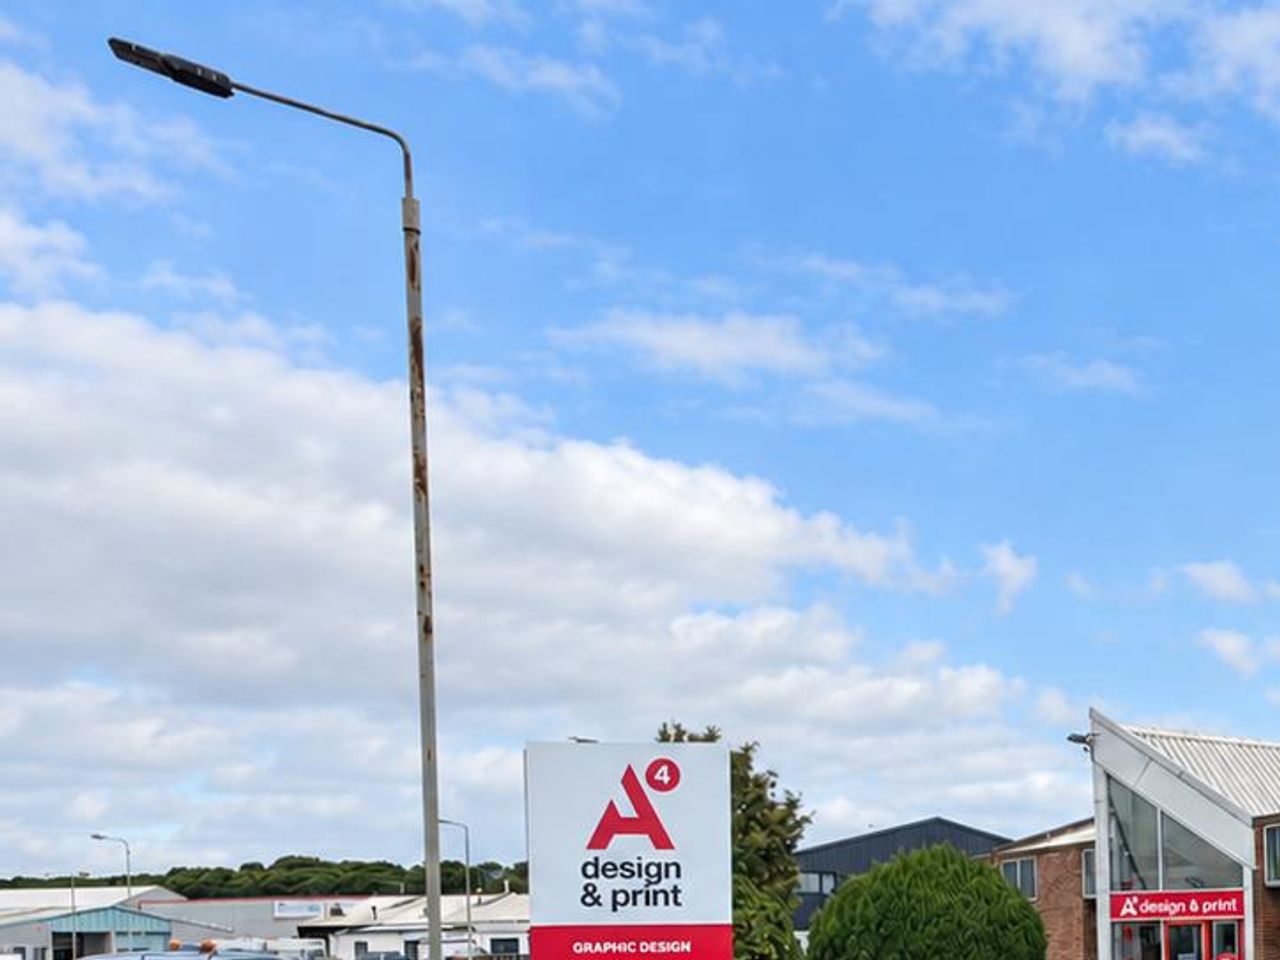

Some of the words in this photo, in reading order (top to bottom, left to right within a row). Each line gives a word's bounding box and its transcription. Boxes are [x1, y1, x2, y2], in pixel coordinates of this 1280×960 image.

[580, 856, 682, 888] design
[580, 882, 603, 908] &
[611, 884, 682, 912] print
[1139, 899, 1186, 915] design
[1202, 898, 1237, 914] print
[572, 941, 637, 954] GRAPHIC
[639, 940, 692, 953] DESIGN
